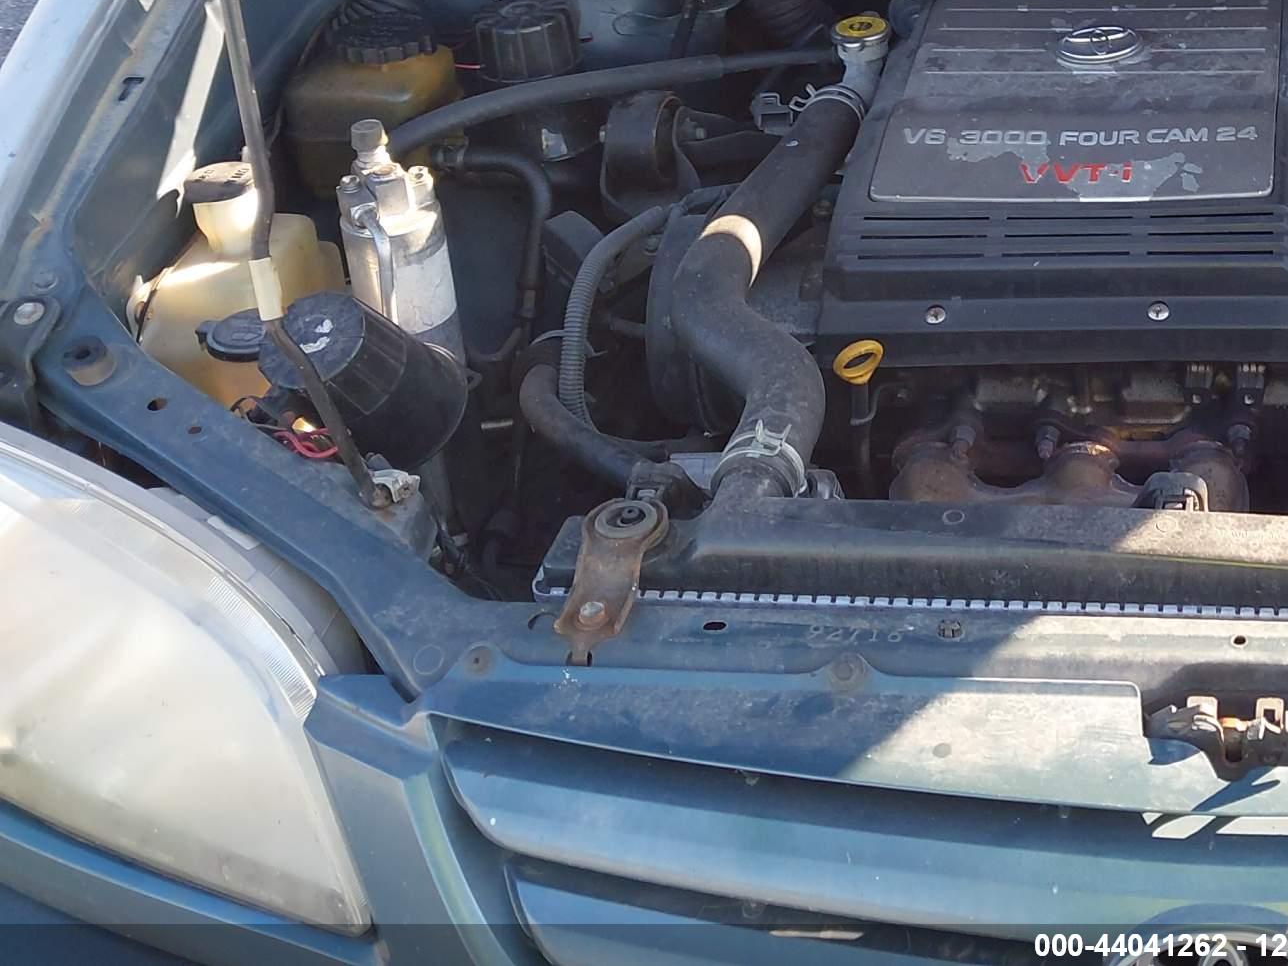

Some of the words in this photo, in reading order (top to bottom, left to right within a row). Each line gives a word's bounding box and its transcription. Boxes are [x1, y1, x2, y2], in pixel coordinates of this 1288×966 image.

[903, 127, 947, 146] V6
[959, 128, 1048, 146] 3000
[1058, 128, 1140, 147] FOUR
[1146, 126, 1208, 145] CAM
[1215, 125, 1259, 143] 24
